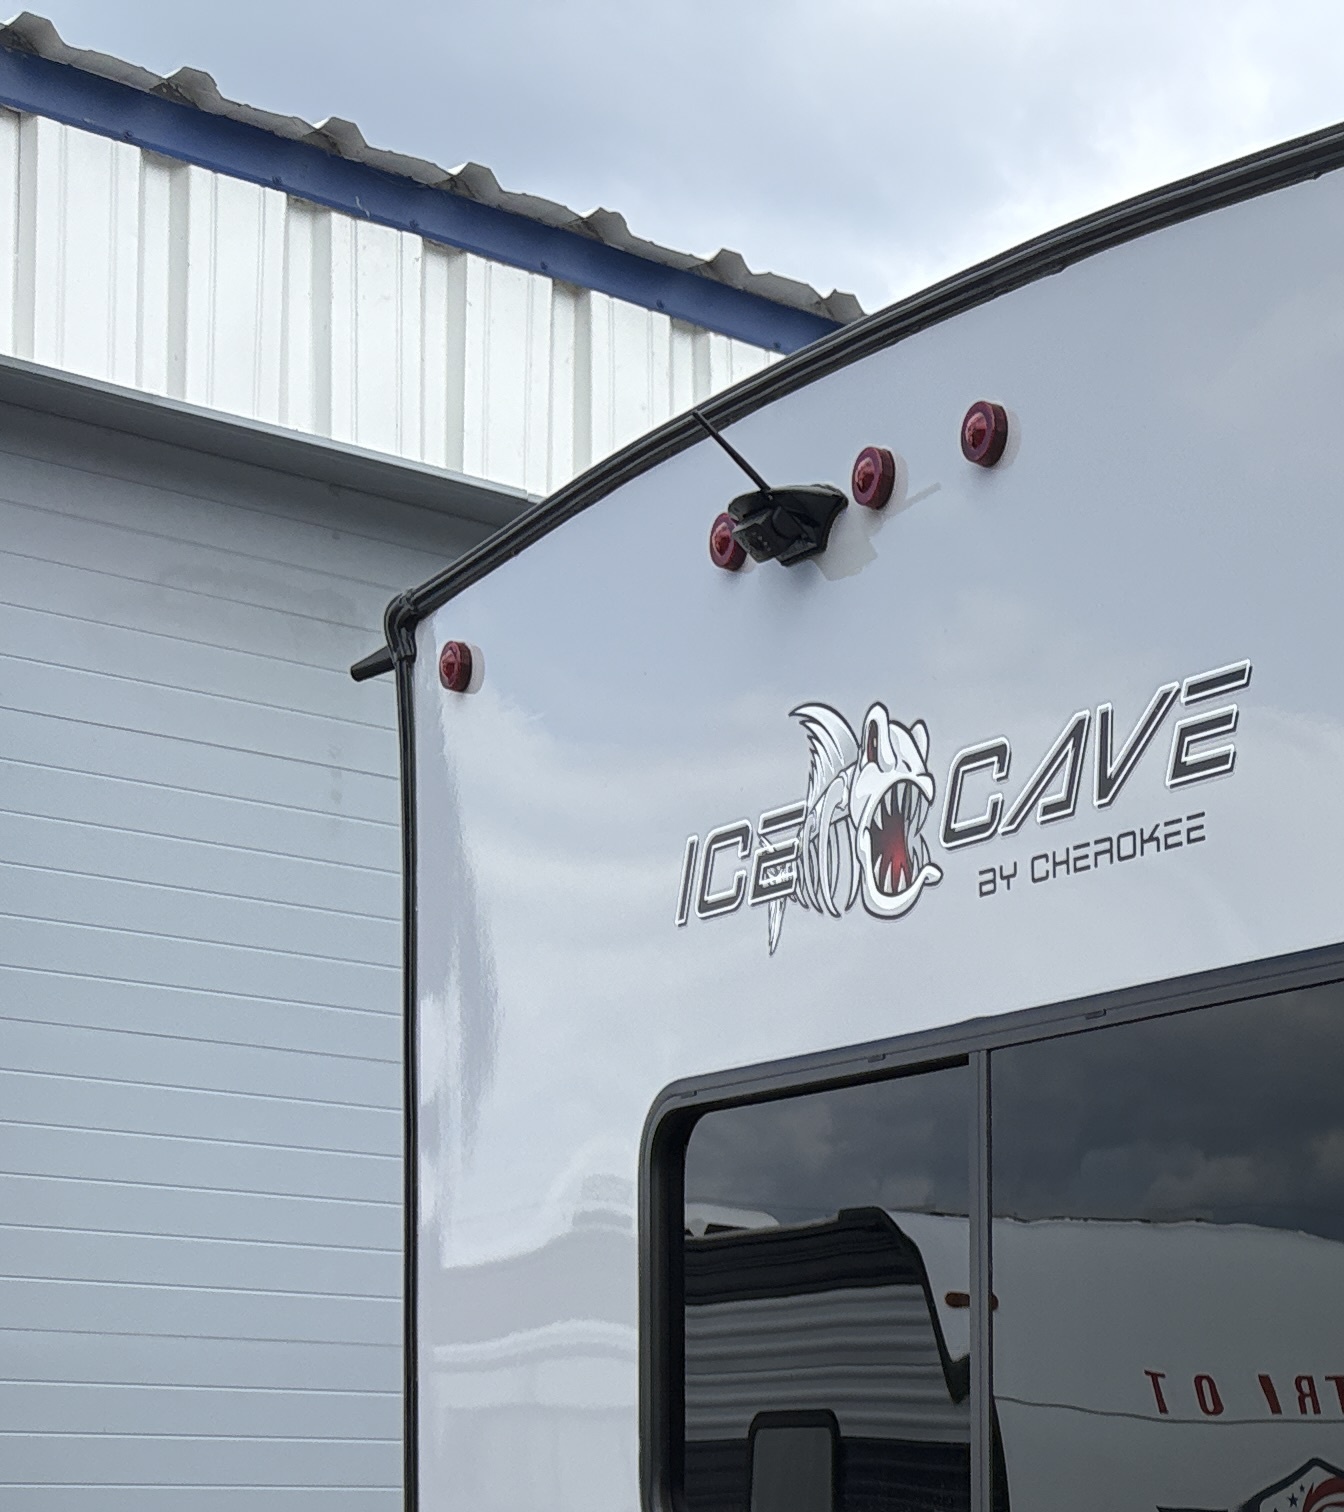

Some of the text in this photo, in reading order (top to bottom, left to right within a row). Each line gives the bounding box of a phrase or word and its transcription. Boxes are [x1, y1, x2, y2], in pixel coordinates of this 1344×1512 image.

[675, 658, 1253, 927] ICE CAVE
[978, 811, 1206, 898] BY CHEROKEE
